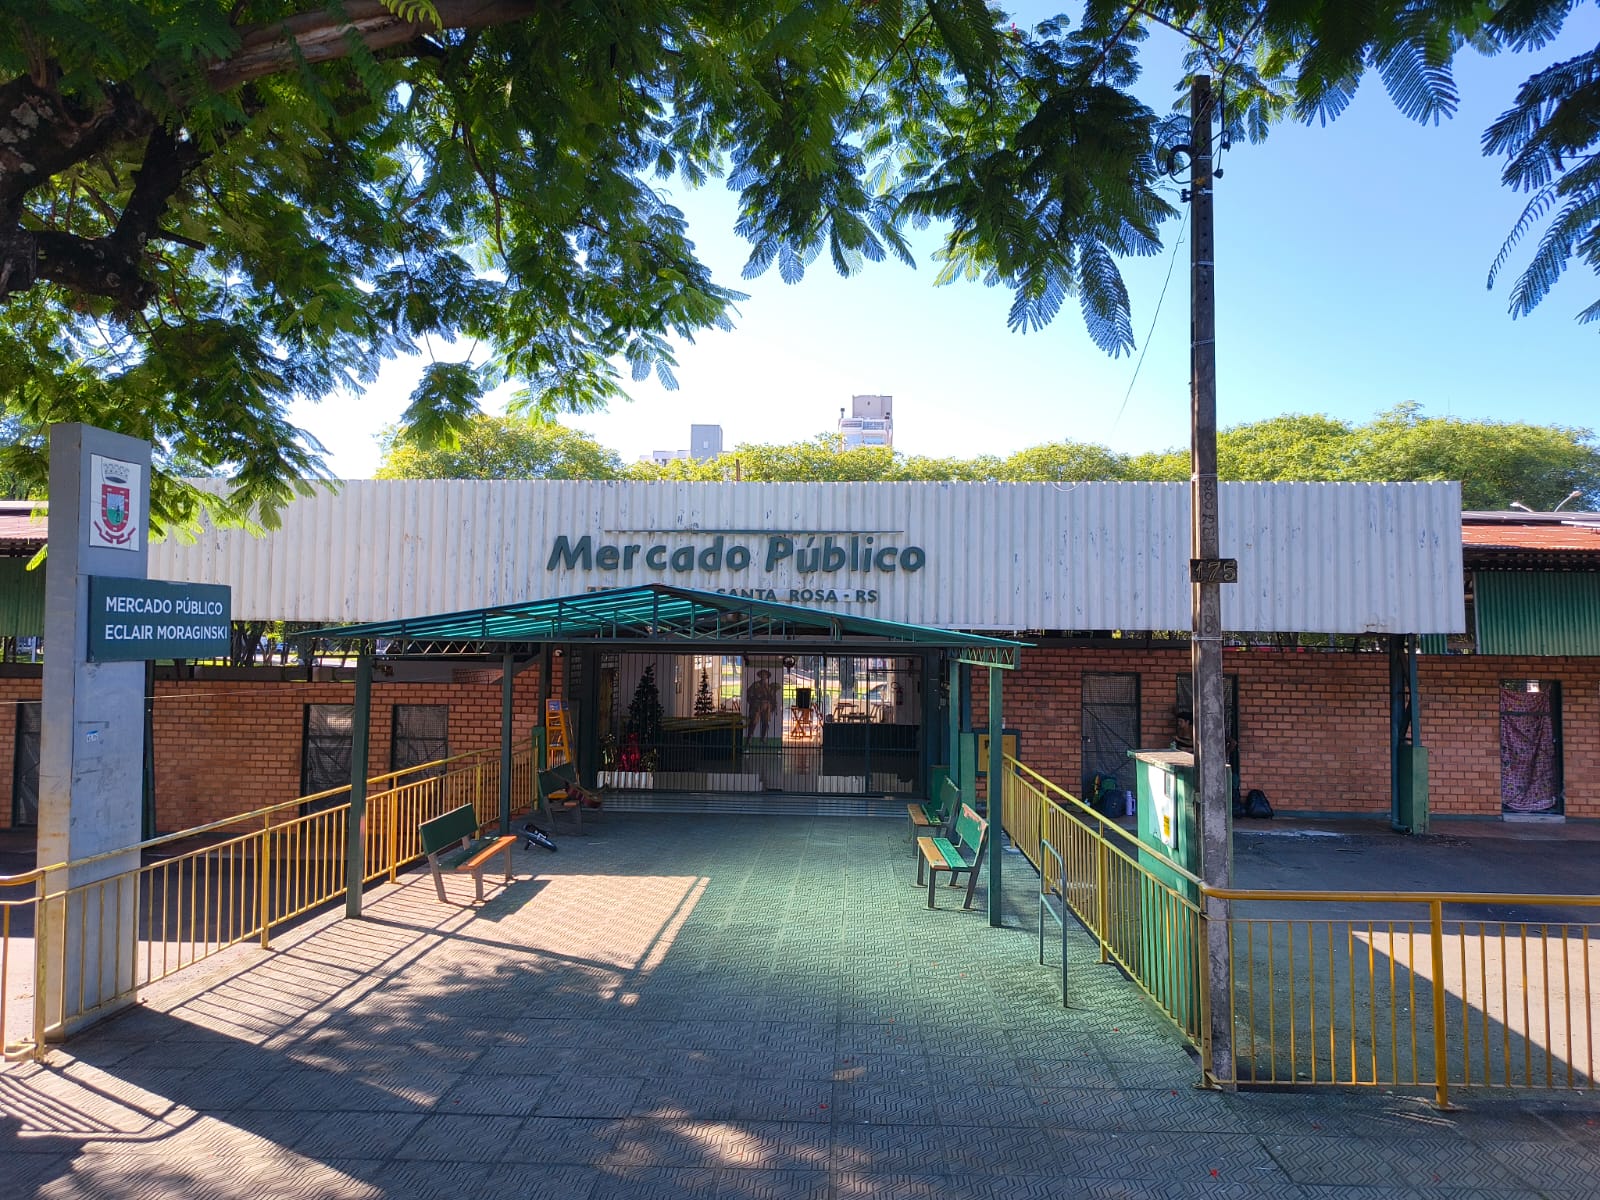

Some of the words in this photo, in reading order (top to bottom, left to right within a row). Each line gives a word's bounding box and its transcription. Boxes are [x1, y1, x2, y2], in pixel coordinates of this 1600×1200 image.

[547, 536, 751, 572] Mercado
[765, 536, 926, 573] Público
[1195, 561, 1236, 581] 175
[106, 596, 172, 614] MERCADO
[175, 597, 223, 616] PÚBLICO
[789, 589, 838, 603] ROSA
[855, 590, 878, 603] RS
[105, 624, 153, 640] ECLAIR
[157, 625, 227, 640] MORAGINSKI
